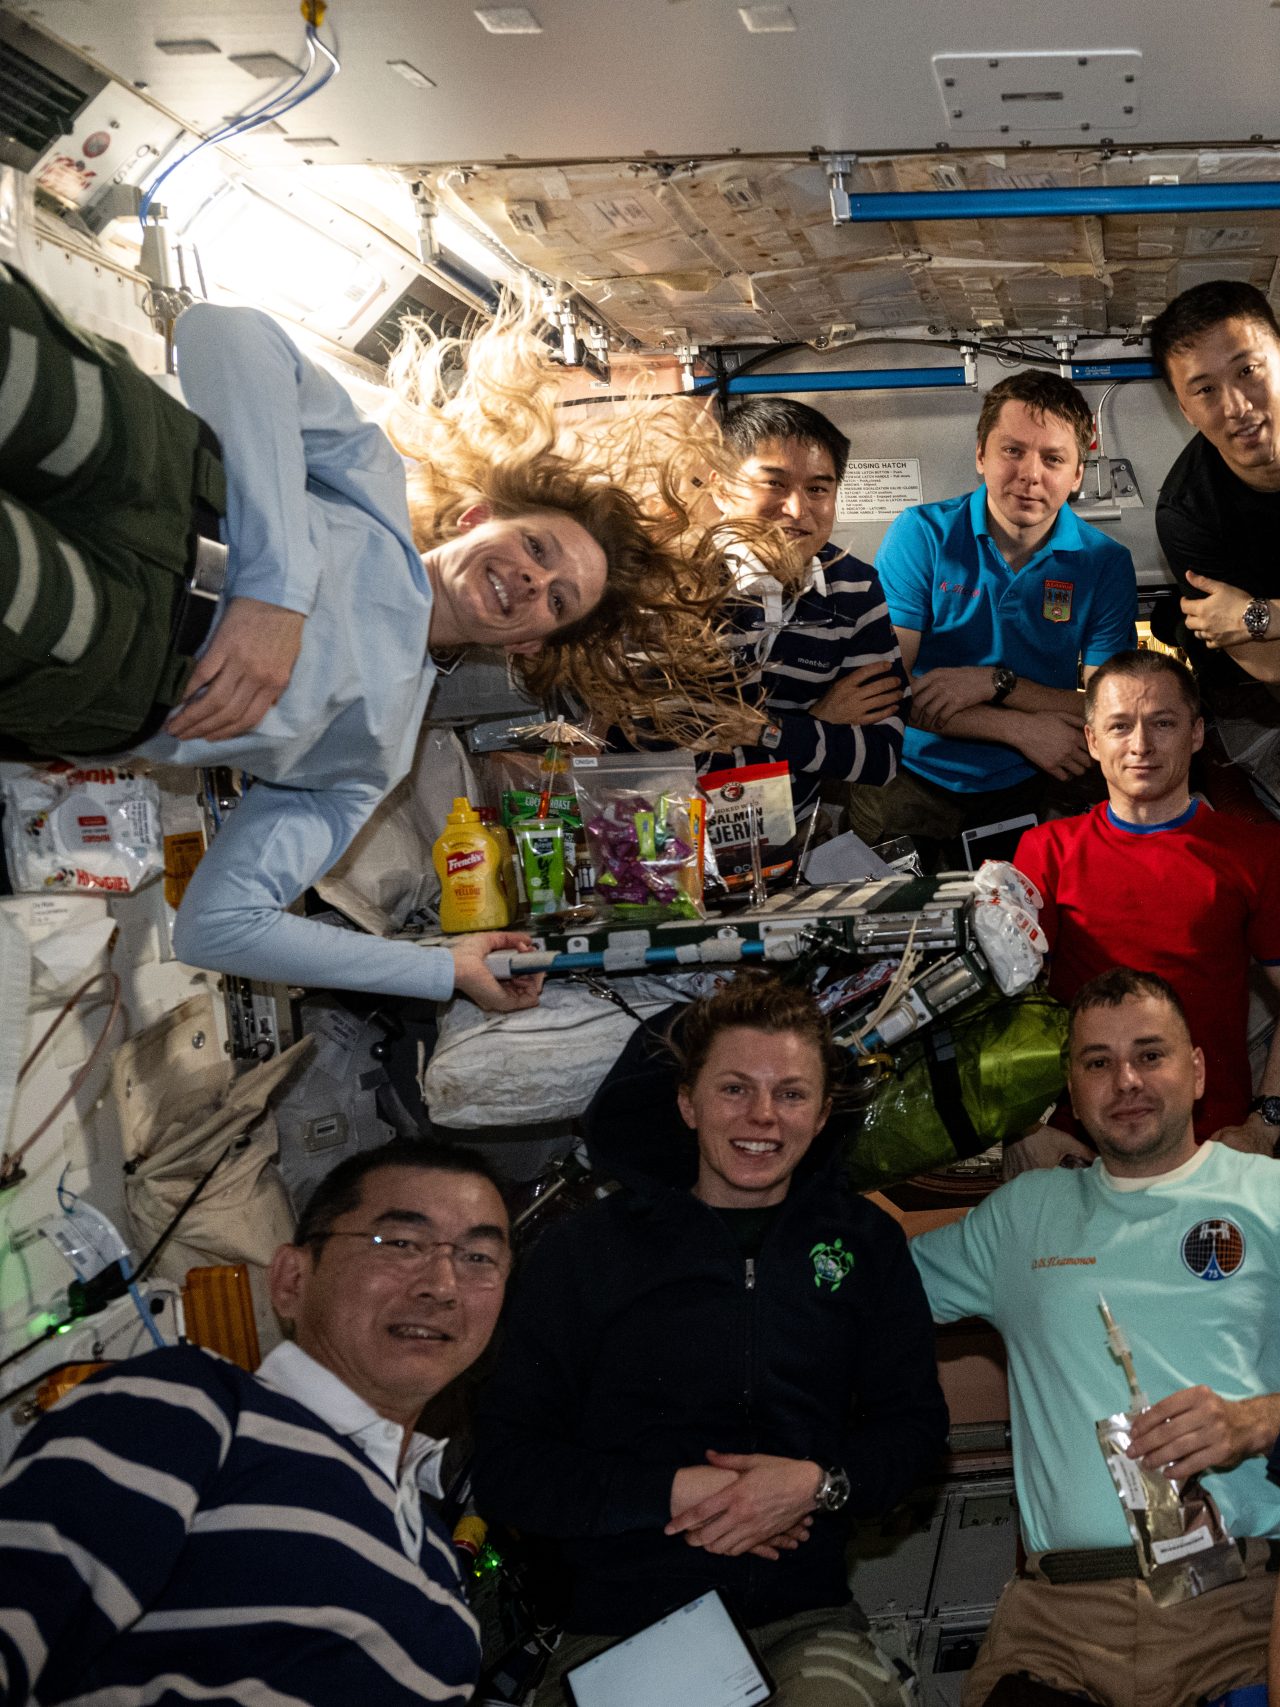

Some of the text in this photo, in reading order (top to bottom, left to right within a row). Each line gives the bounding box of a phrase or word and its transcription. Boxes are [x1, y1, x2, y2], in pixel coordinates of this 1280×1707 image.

[848, 462, 880, 470] CLOSING
[714, 805, 740, 814] MOKED
[707, 807, 763, 826] SALMON
[448, 854, 484, 872] French's
[1208, 1269, 1219, 1279] 73
